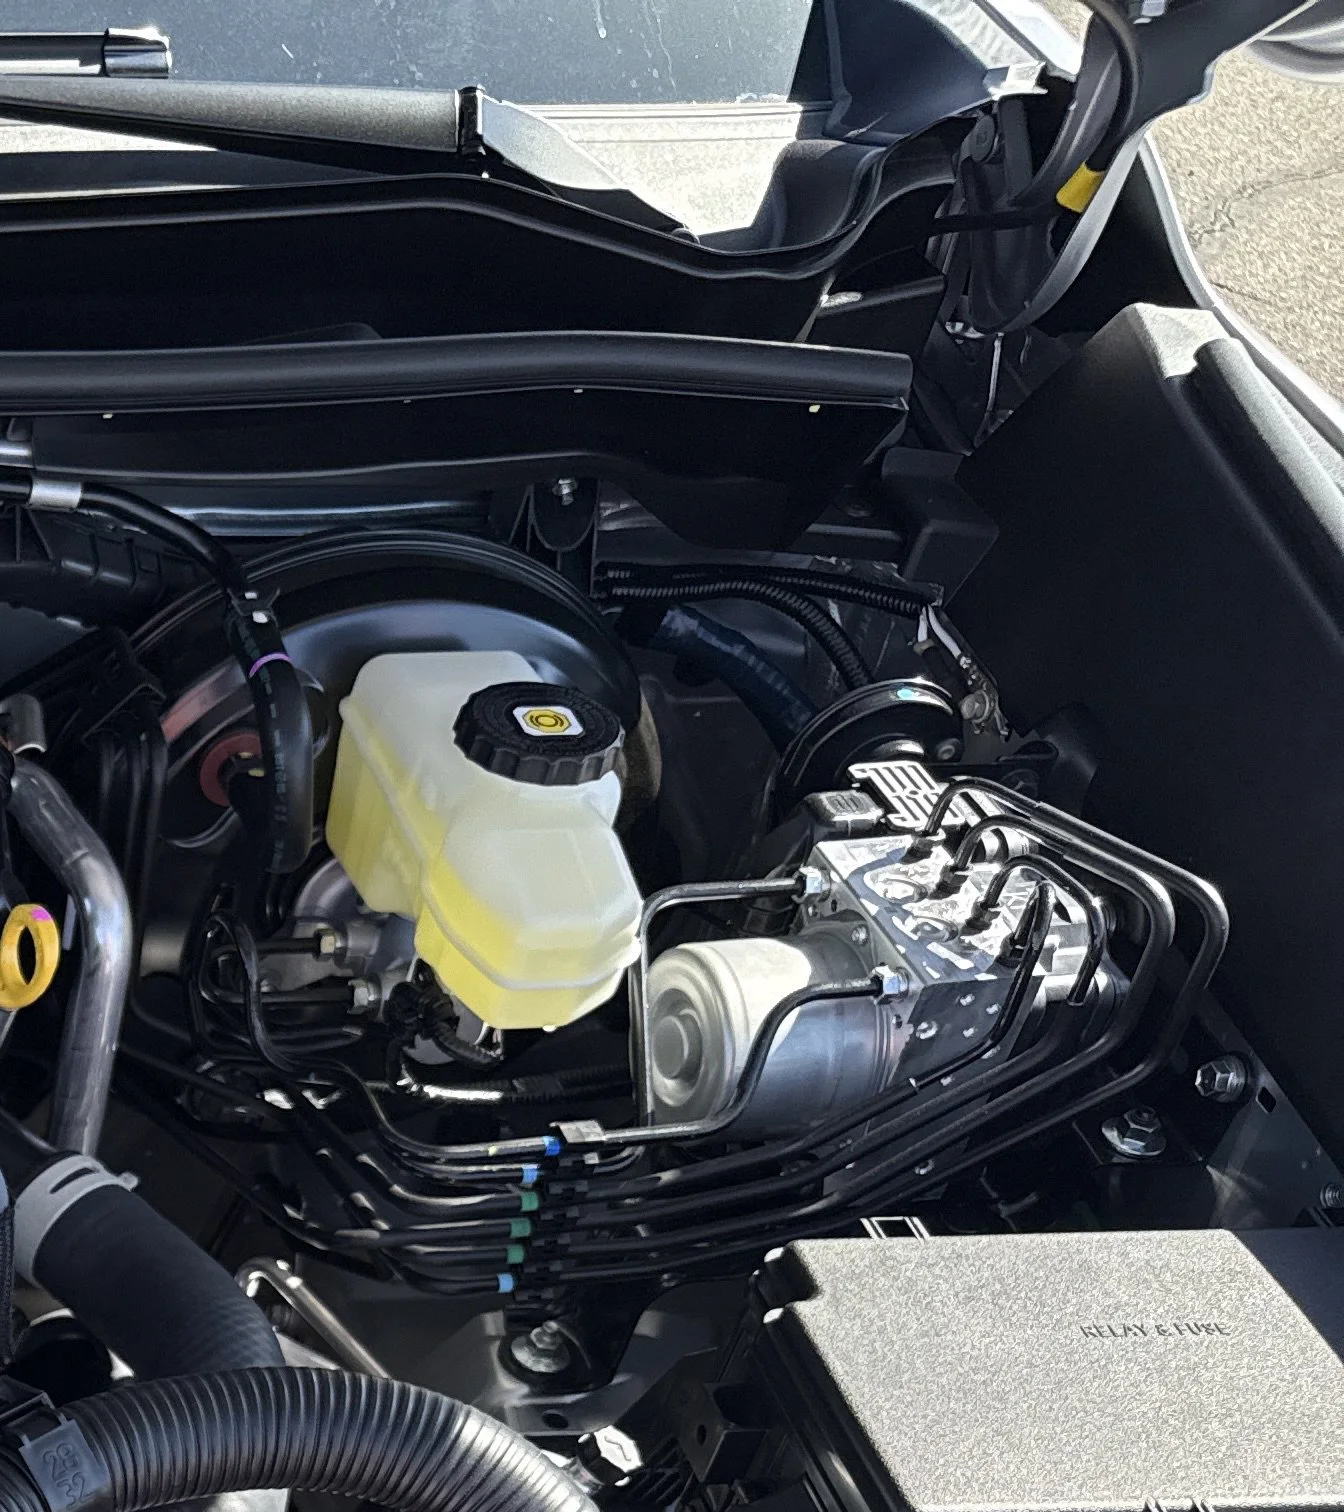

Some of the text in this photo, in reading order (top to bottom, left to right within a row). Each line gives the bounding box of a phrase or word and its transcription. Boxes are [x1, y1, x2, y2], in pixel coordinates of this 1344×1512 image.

[1080, 1322, 1231, 1338] RELAY & FUSE
